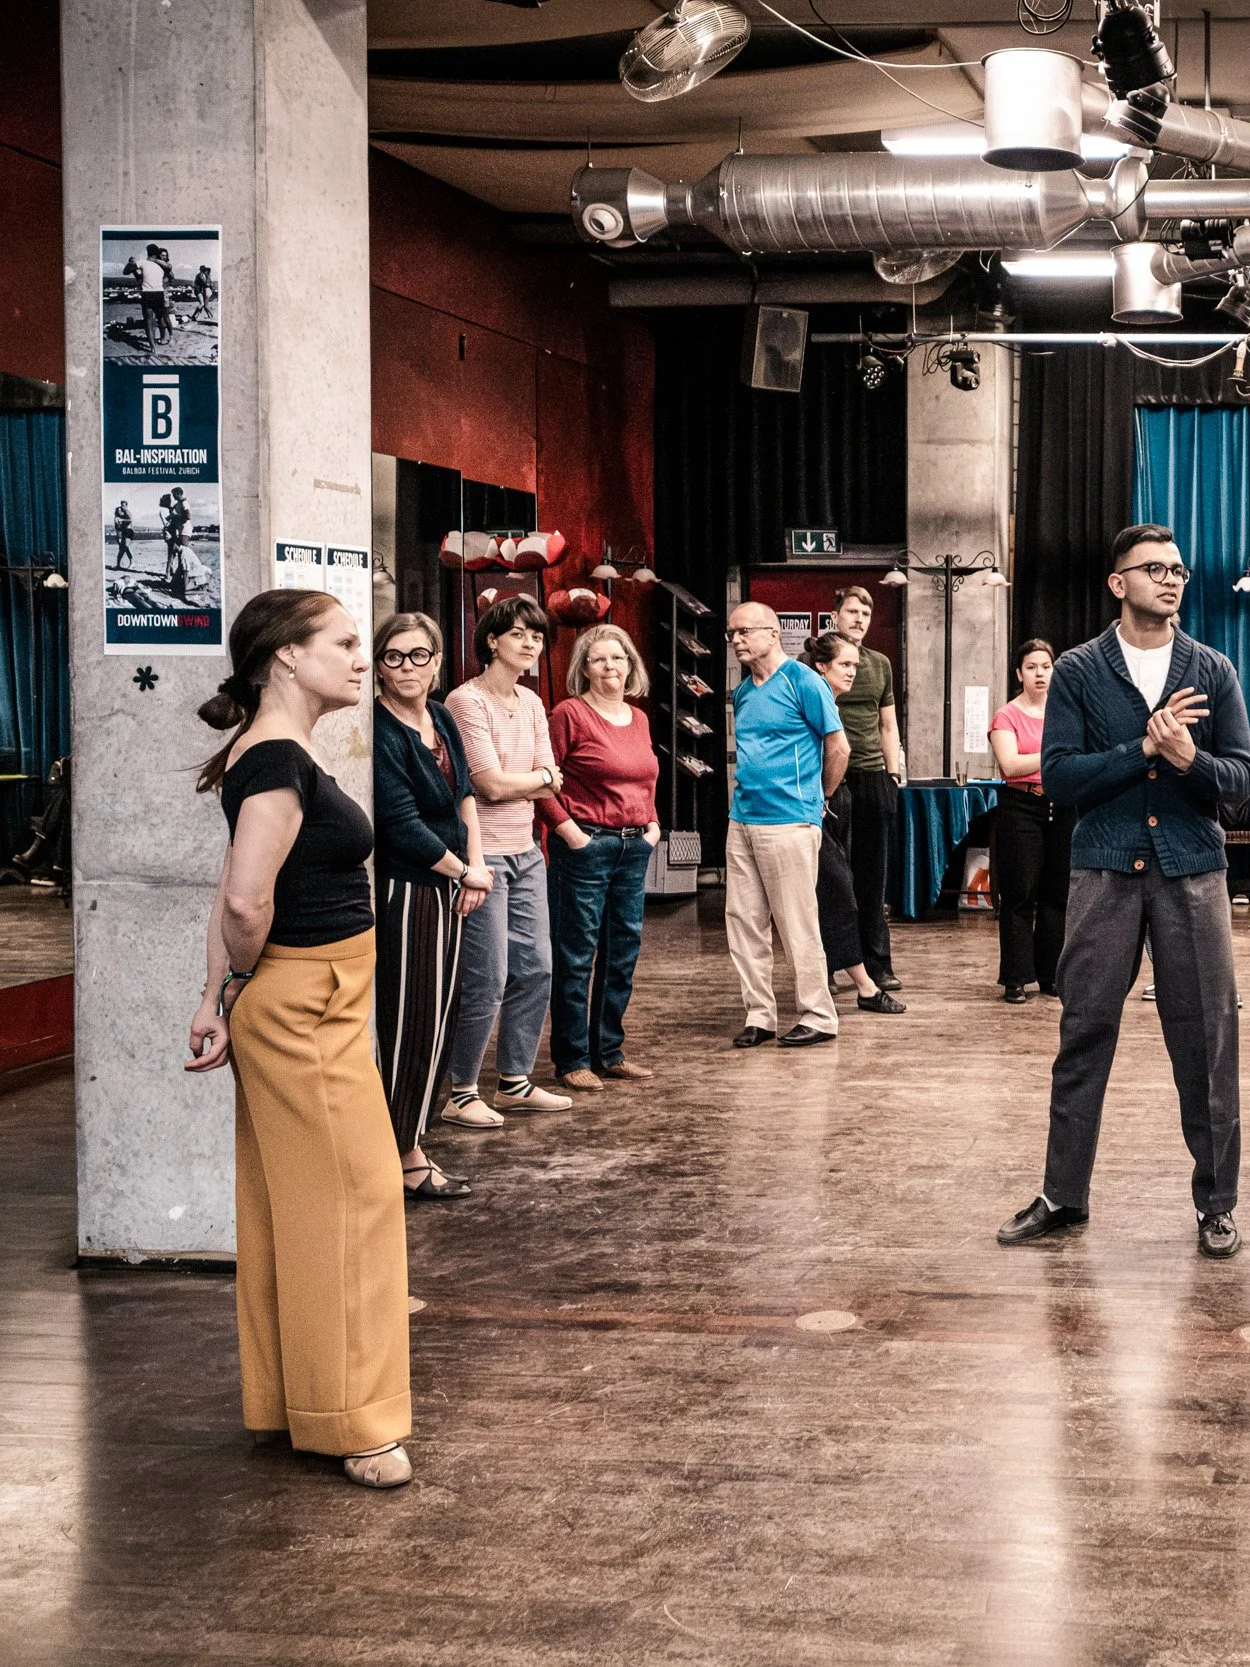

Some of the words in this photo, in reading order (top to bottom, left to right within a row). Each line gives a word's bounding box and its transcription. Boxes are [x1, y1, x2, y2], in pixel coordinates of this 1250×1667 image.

[152, 394, 172, 440] B
[115, 448, 207, 464] BAL-INSPIRATION
[122, 467, 146, 475] BALBOA
[148, 467, 176, 475] FESTIVAL
[284, 546, 317, 564] SCHEDULE
[333, 551, 364, 568] SCHEDULE
[780, 618, 809, 631] TURDAY
